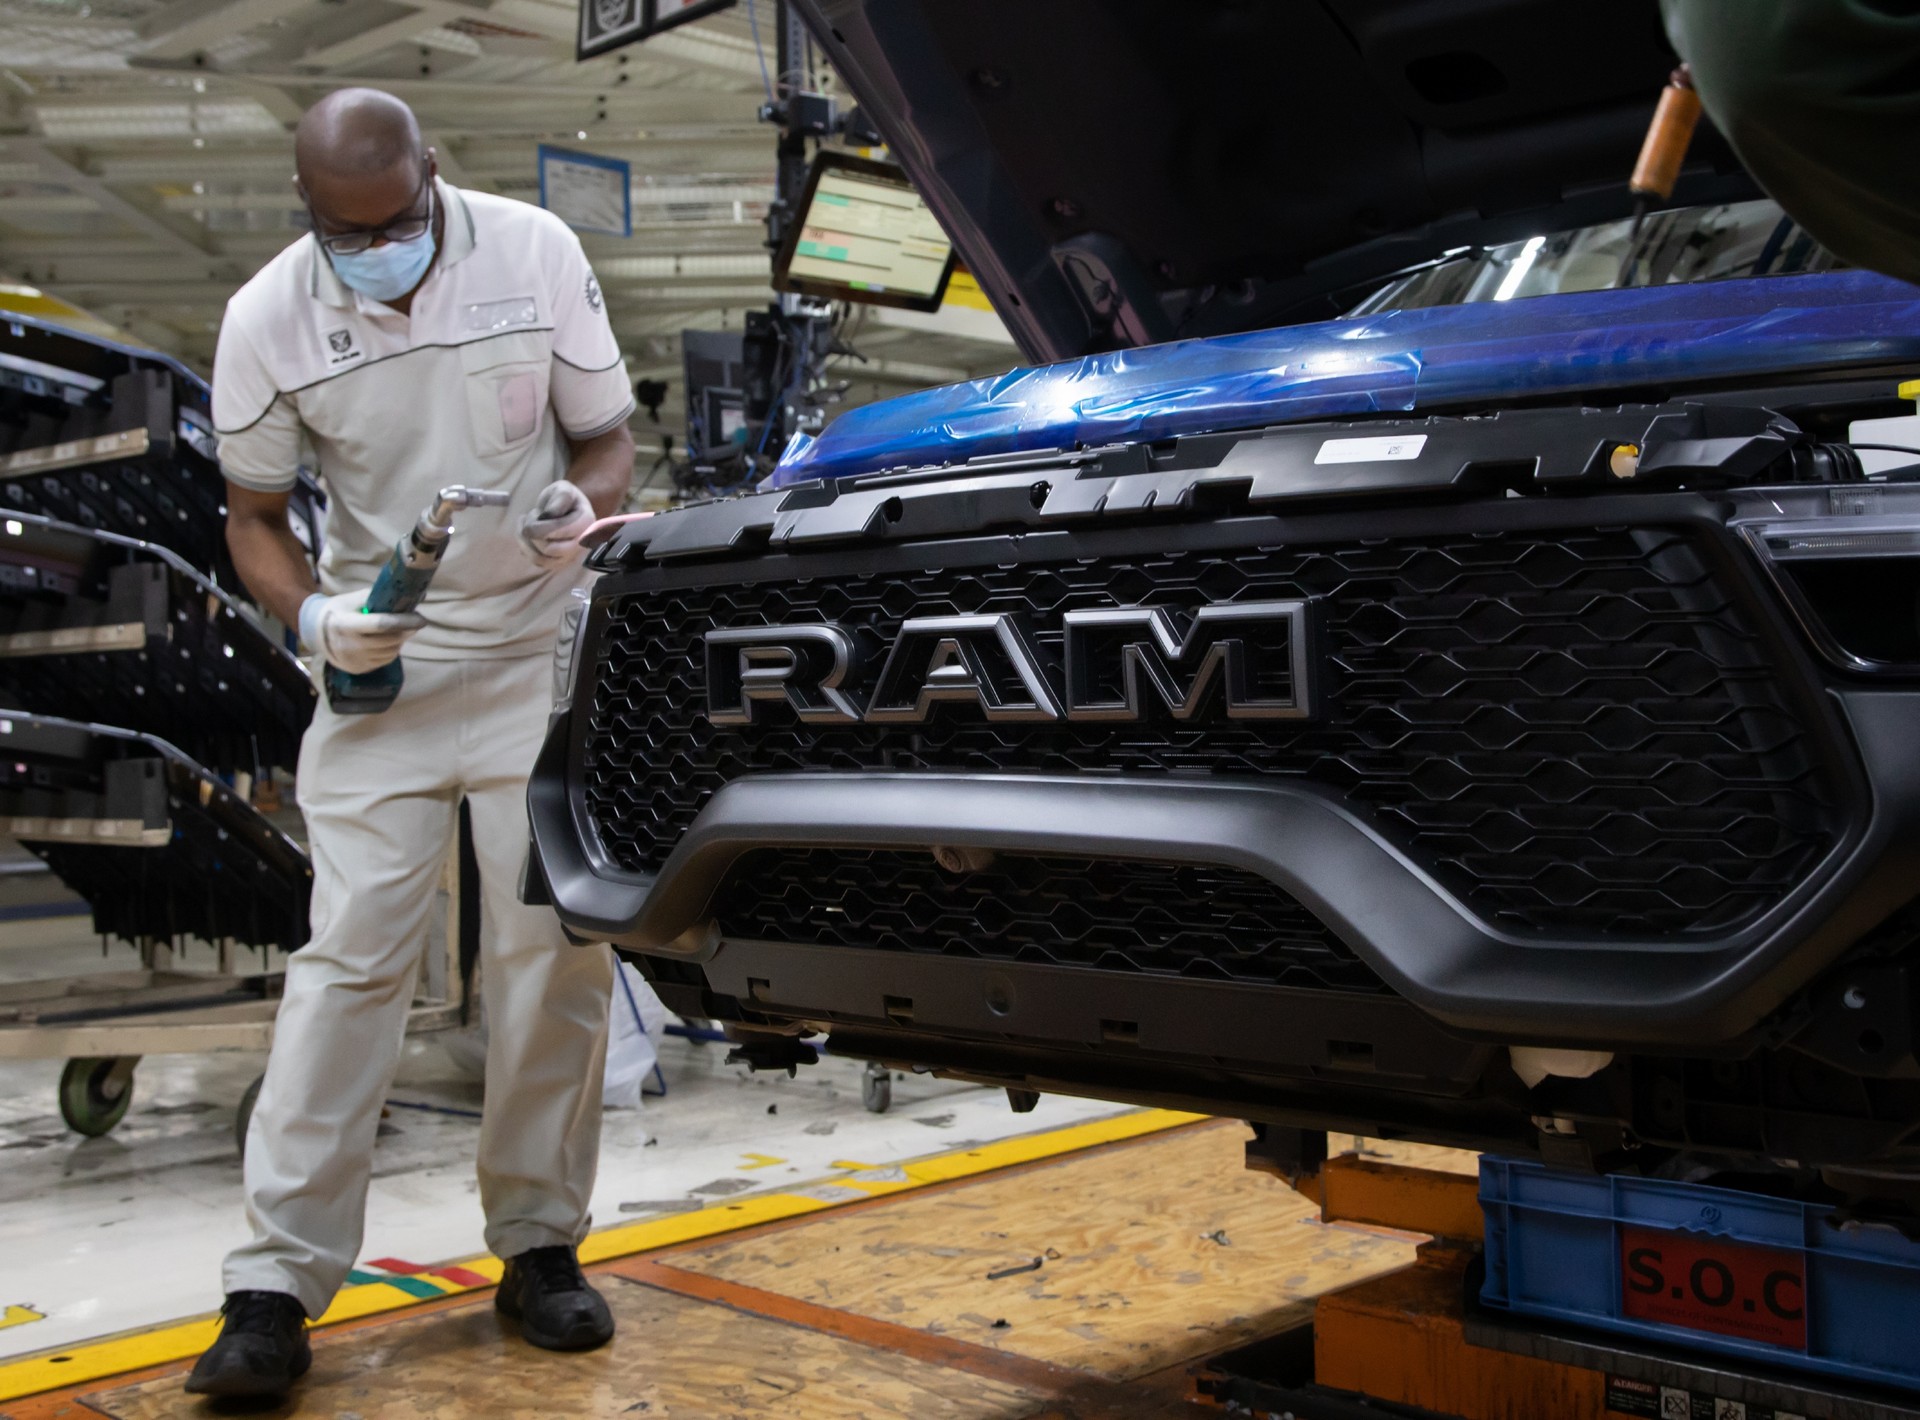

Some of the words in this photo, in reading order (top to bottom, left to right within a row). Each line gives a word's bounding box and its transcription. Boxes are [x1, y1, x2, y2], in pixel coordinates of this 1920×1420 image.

[704, 600, 1312, 724] RAM
[1628, 1248, 1803, 1320] S.O.C
[1622, 1380, 1654, 1393] DANGER
